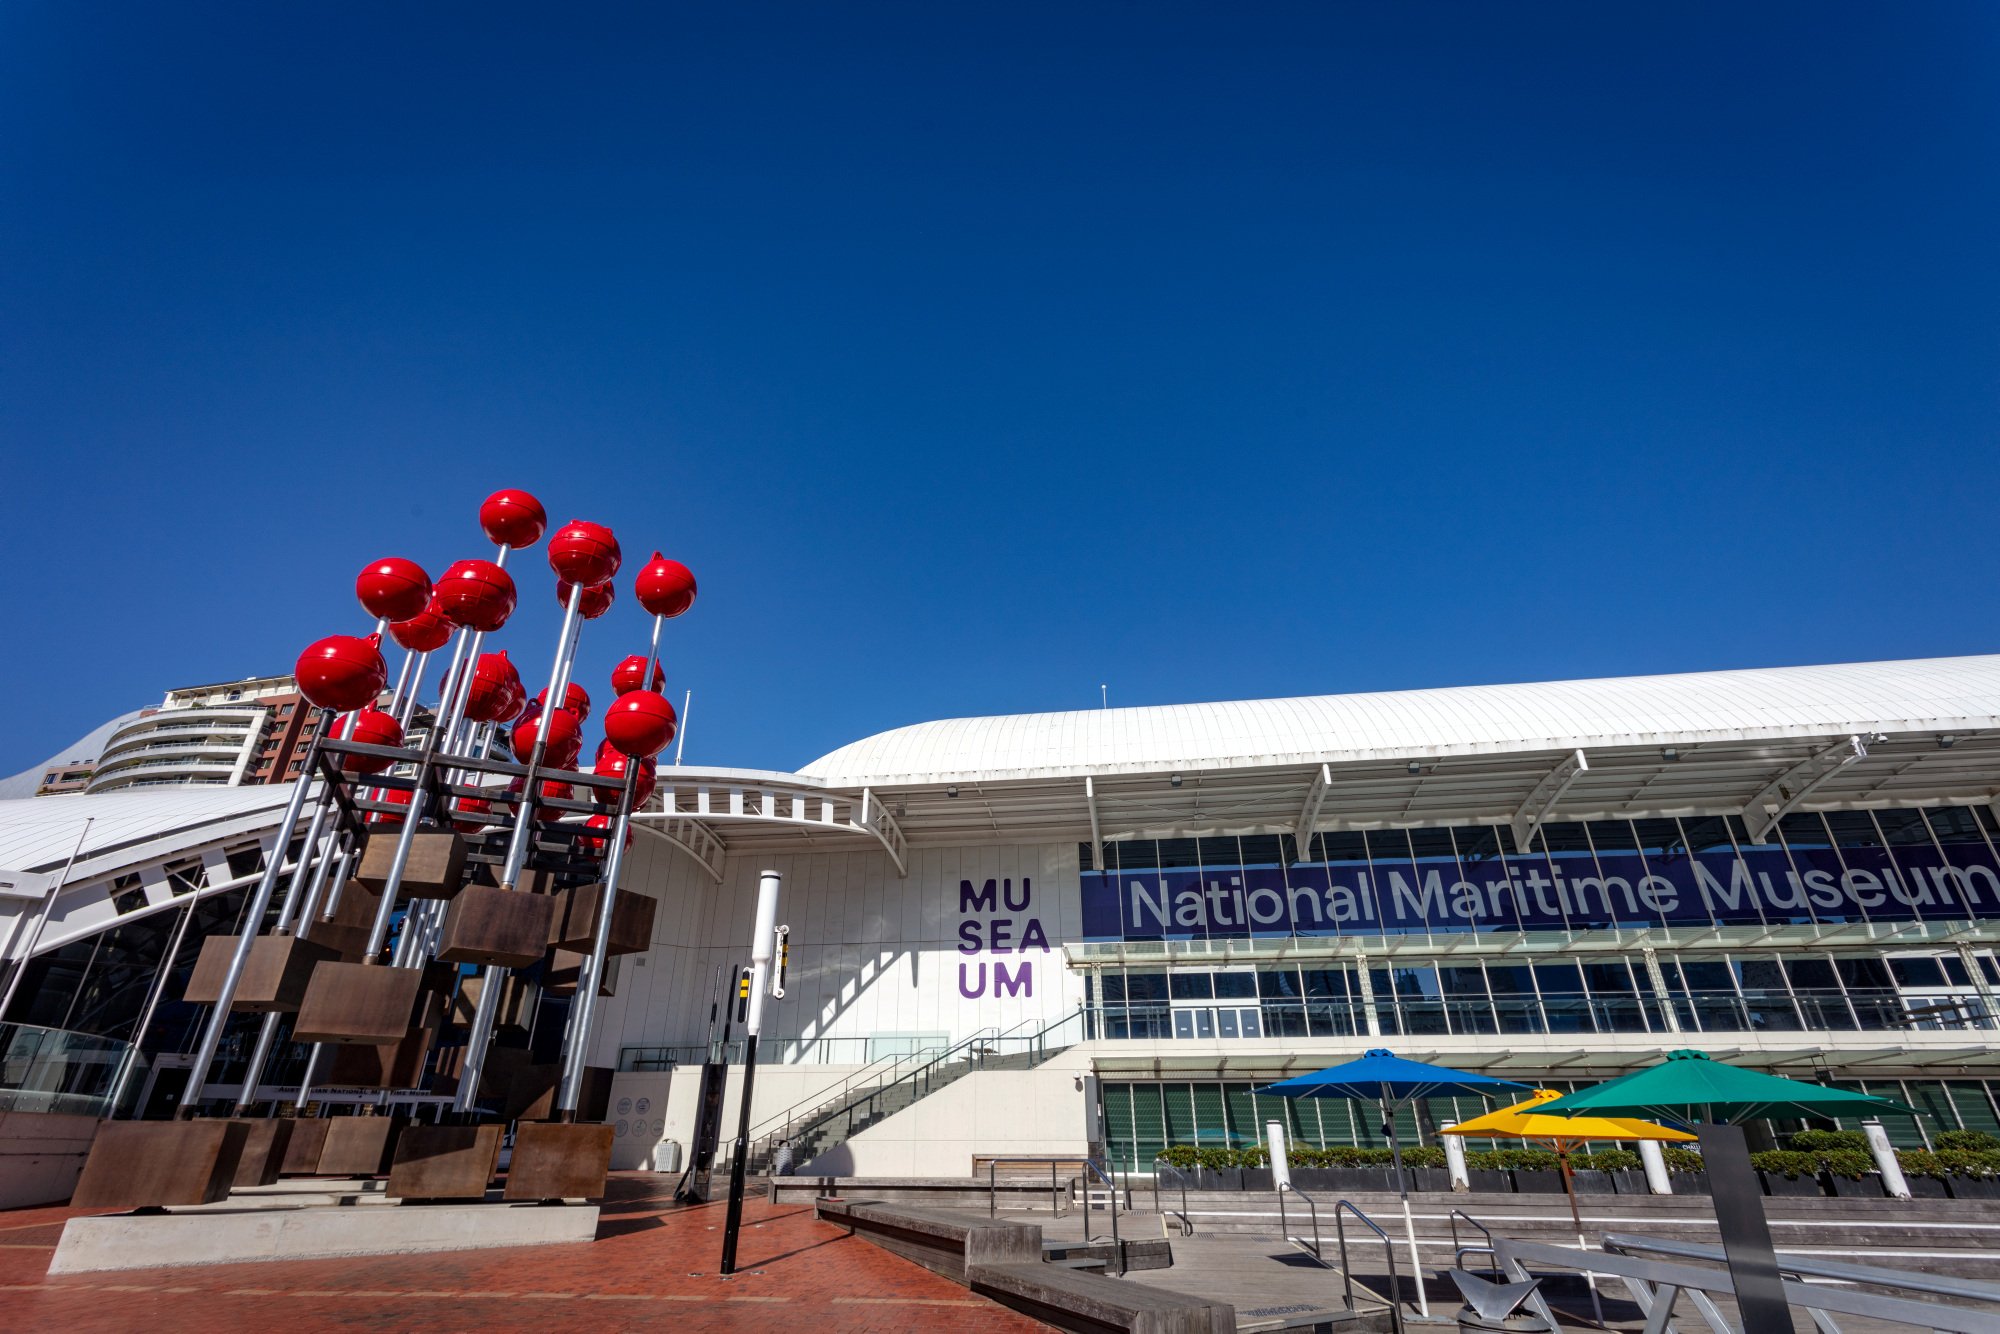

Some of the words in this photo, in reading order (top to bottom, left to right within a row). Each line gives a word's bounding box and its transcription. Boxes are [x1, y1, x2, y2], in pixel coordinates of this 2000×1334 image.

[960, 878, 1030, 913] MU
[1130, 872, 1375, 928] National
[1388, 865, 1680, 920] Maritime
[1689, 859, 2000, 911] Museum
[958, 918, 1050, 956] SEA
[959, 961, 1033, 1000] UM
